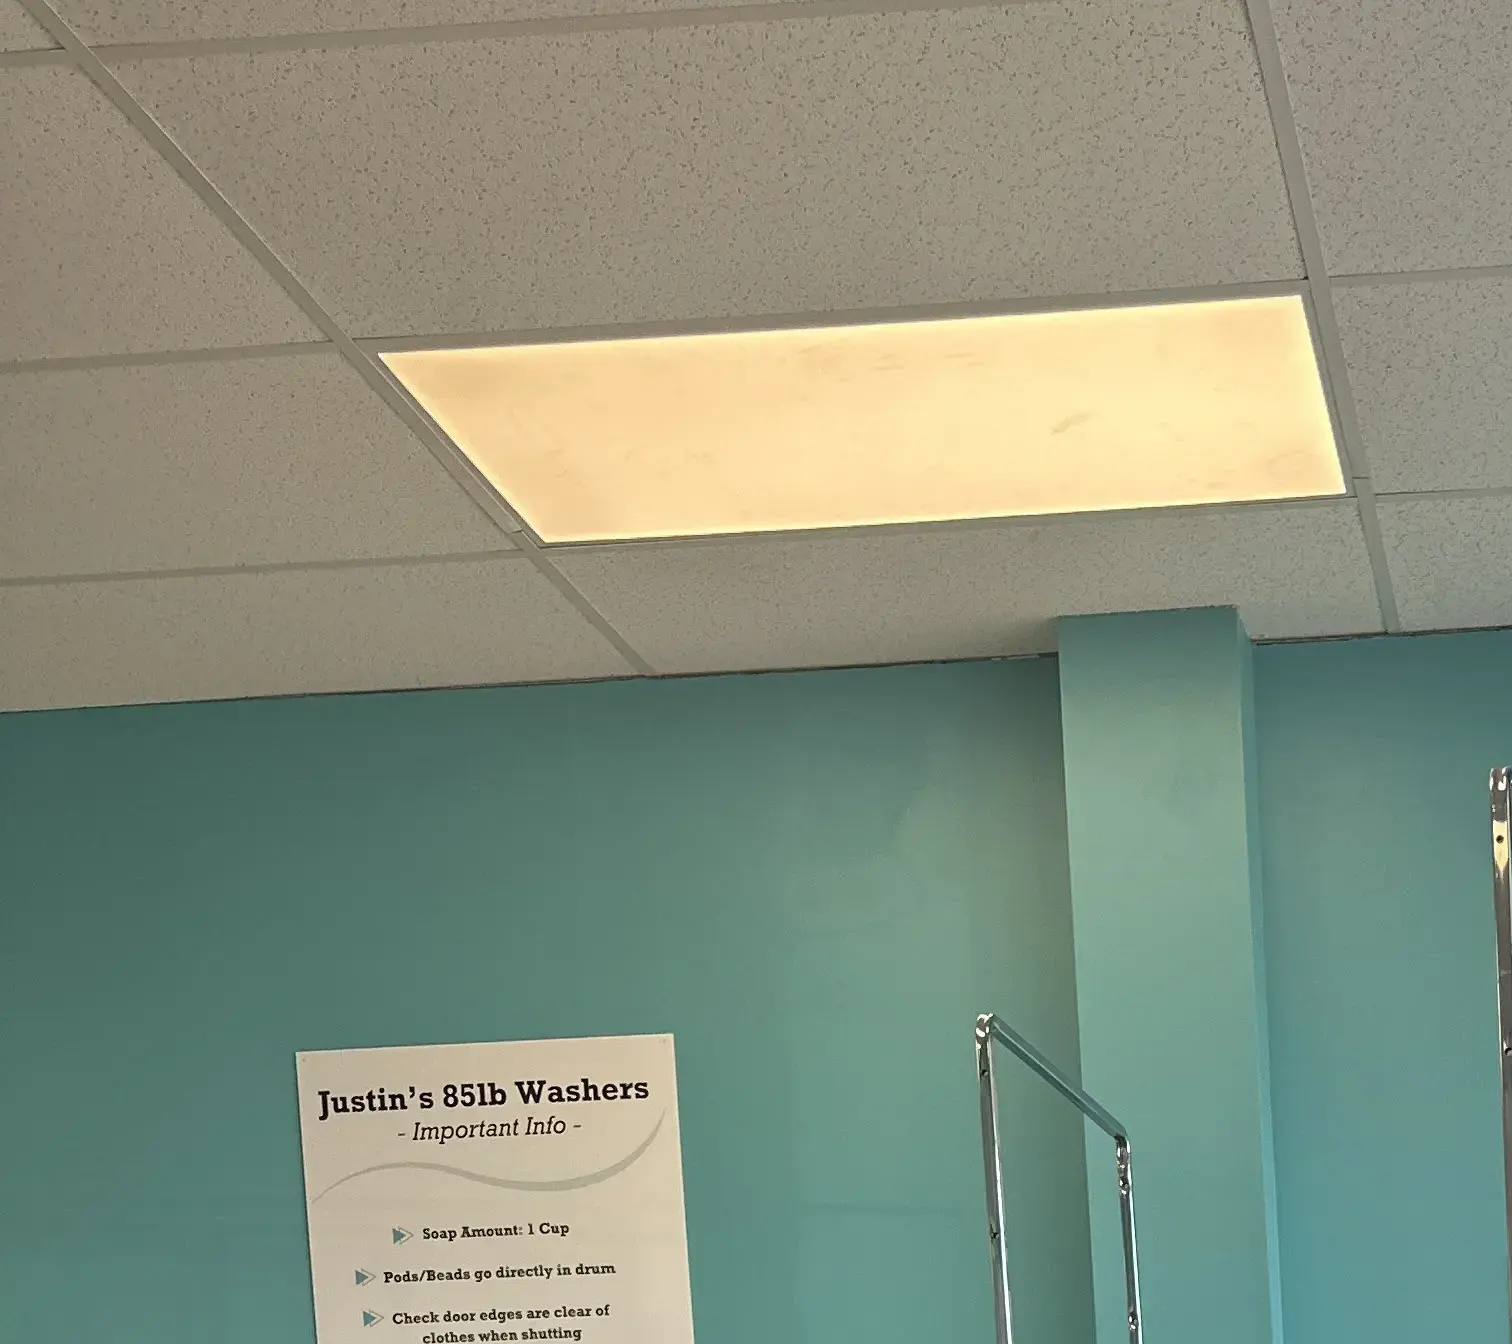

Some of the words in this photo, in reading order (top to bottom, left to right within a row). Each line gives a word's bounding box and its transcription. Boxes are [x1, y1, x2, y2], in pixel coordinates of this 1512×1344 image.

[318, 1086, 434, 1121] Justin's
[443, 1082, 507, 1108] 85lb
[514, 1078, 649, 1104] Washers
[412, 1118, 519, 1144] Important
[524, 1115, 566, 1136] Info
[422, 1227, 458, 1241] Soap
[460, 1224, 523, 1239] Amount:
[527, 1223, 534, 1235] 1
[539, 1222, 570, 1237] Cup
[383, 1269, 471, 1284] Pods/Beads
[474, 1271, 492, 1283] go
[496, 1265, 553, 1280] directly
[556, 1263, 572, 1276] in
[575, 1262, 616, 1275] drum
[392, 1311, 440, 1325] Check
[443, 1310, 476, 1323] door
[479, 1308, 523, 1323] edges
[526, 1309, 550, 1319] are
[554, 1305, 592, 1318] clear
[595, 1304, 611, 1317] of
[422, 1331, 476, 1344] clothes
[478, 1329, 518, 1342] when
[521, 1327, 582, 1342] shutting
